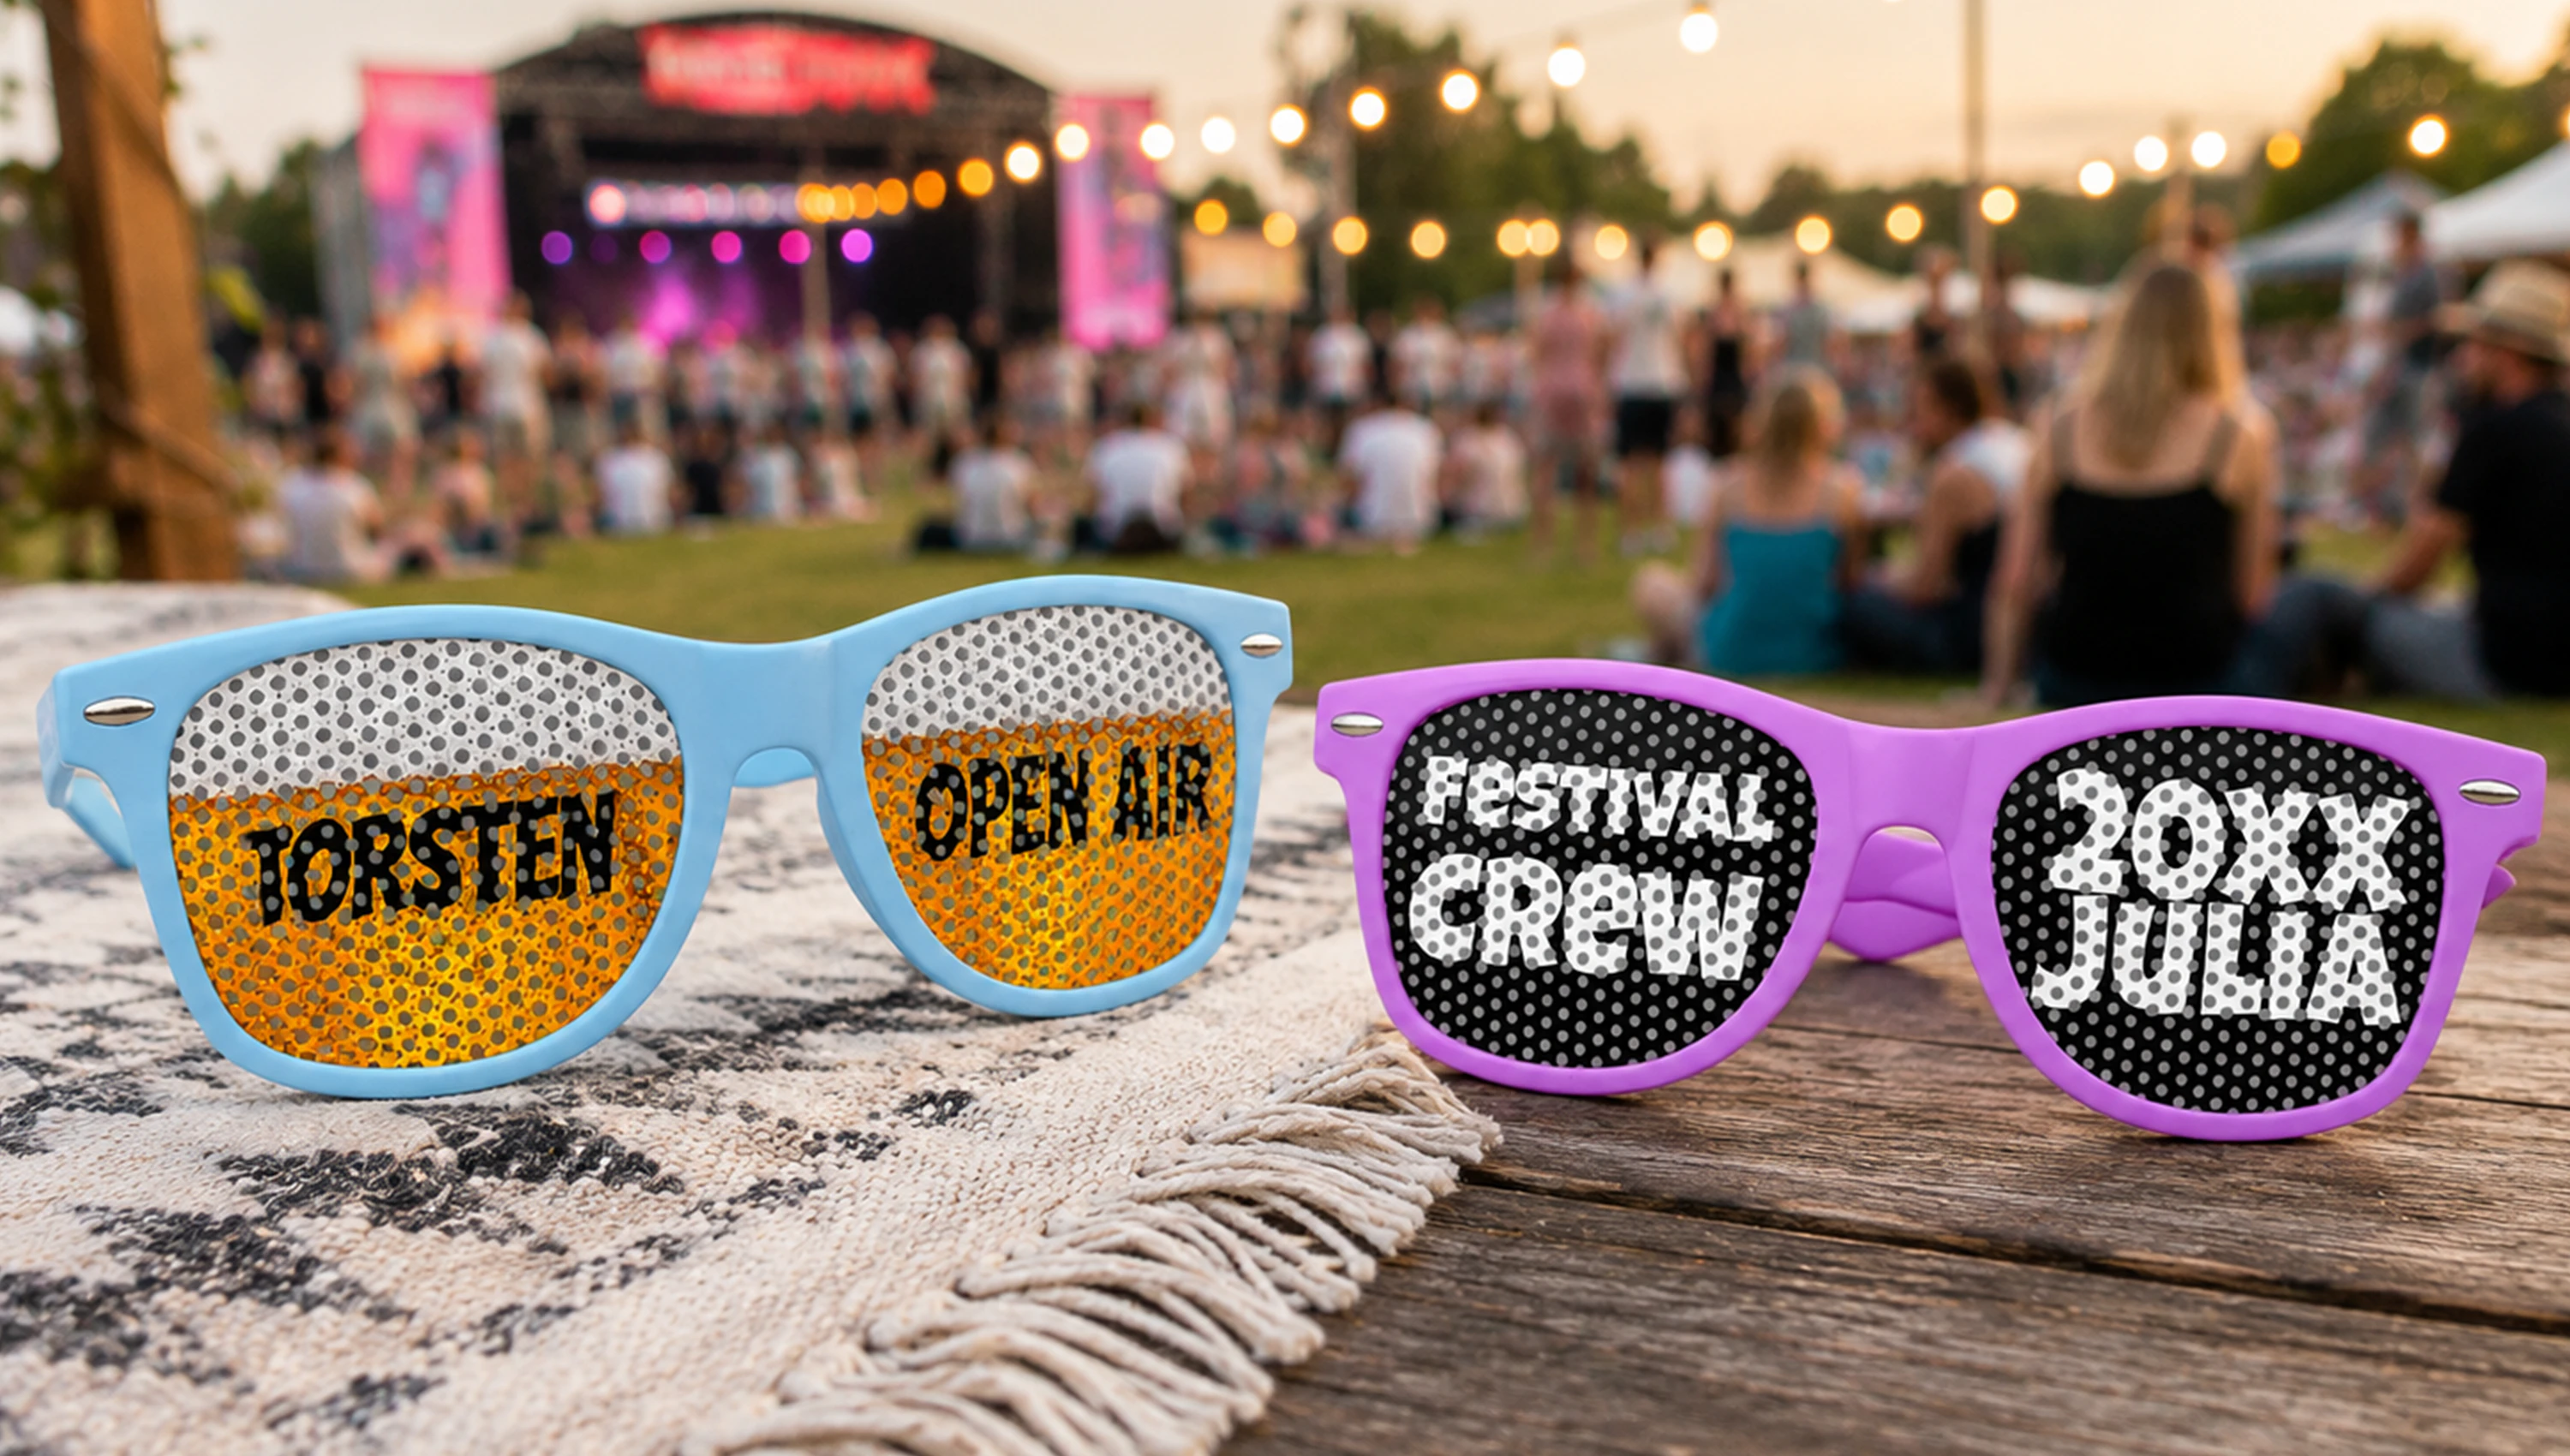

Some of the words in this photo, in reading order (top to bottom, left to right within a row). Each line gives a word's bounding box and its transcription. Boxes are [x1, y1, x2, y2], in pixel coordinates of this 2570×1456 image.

[244, 790, 615, 925] TORSTEN
[916, 750, 1089, 861] OPEN
[1112, 743, 1211, 841] AIR
[2049, 768, 2409, 911] 20XX
[2030, 895, 2400, 1025] JULIA
